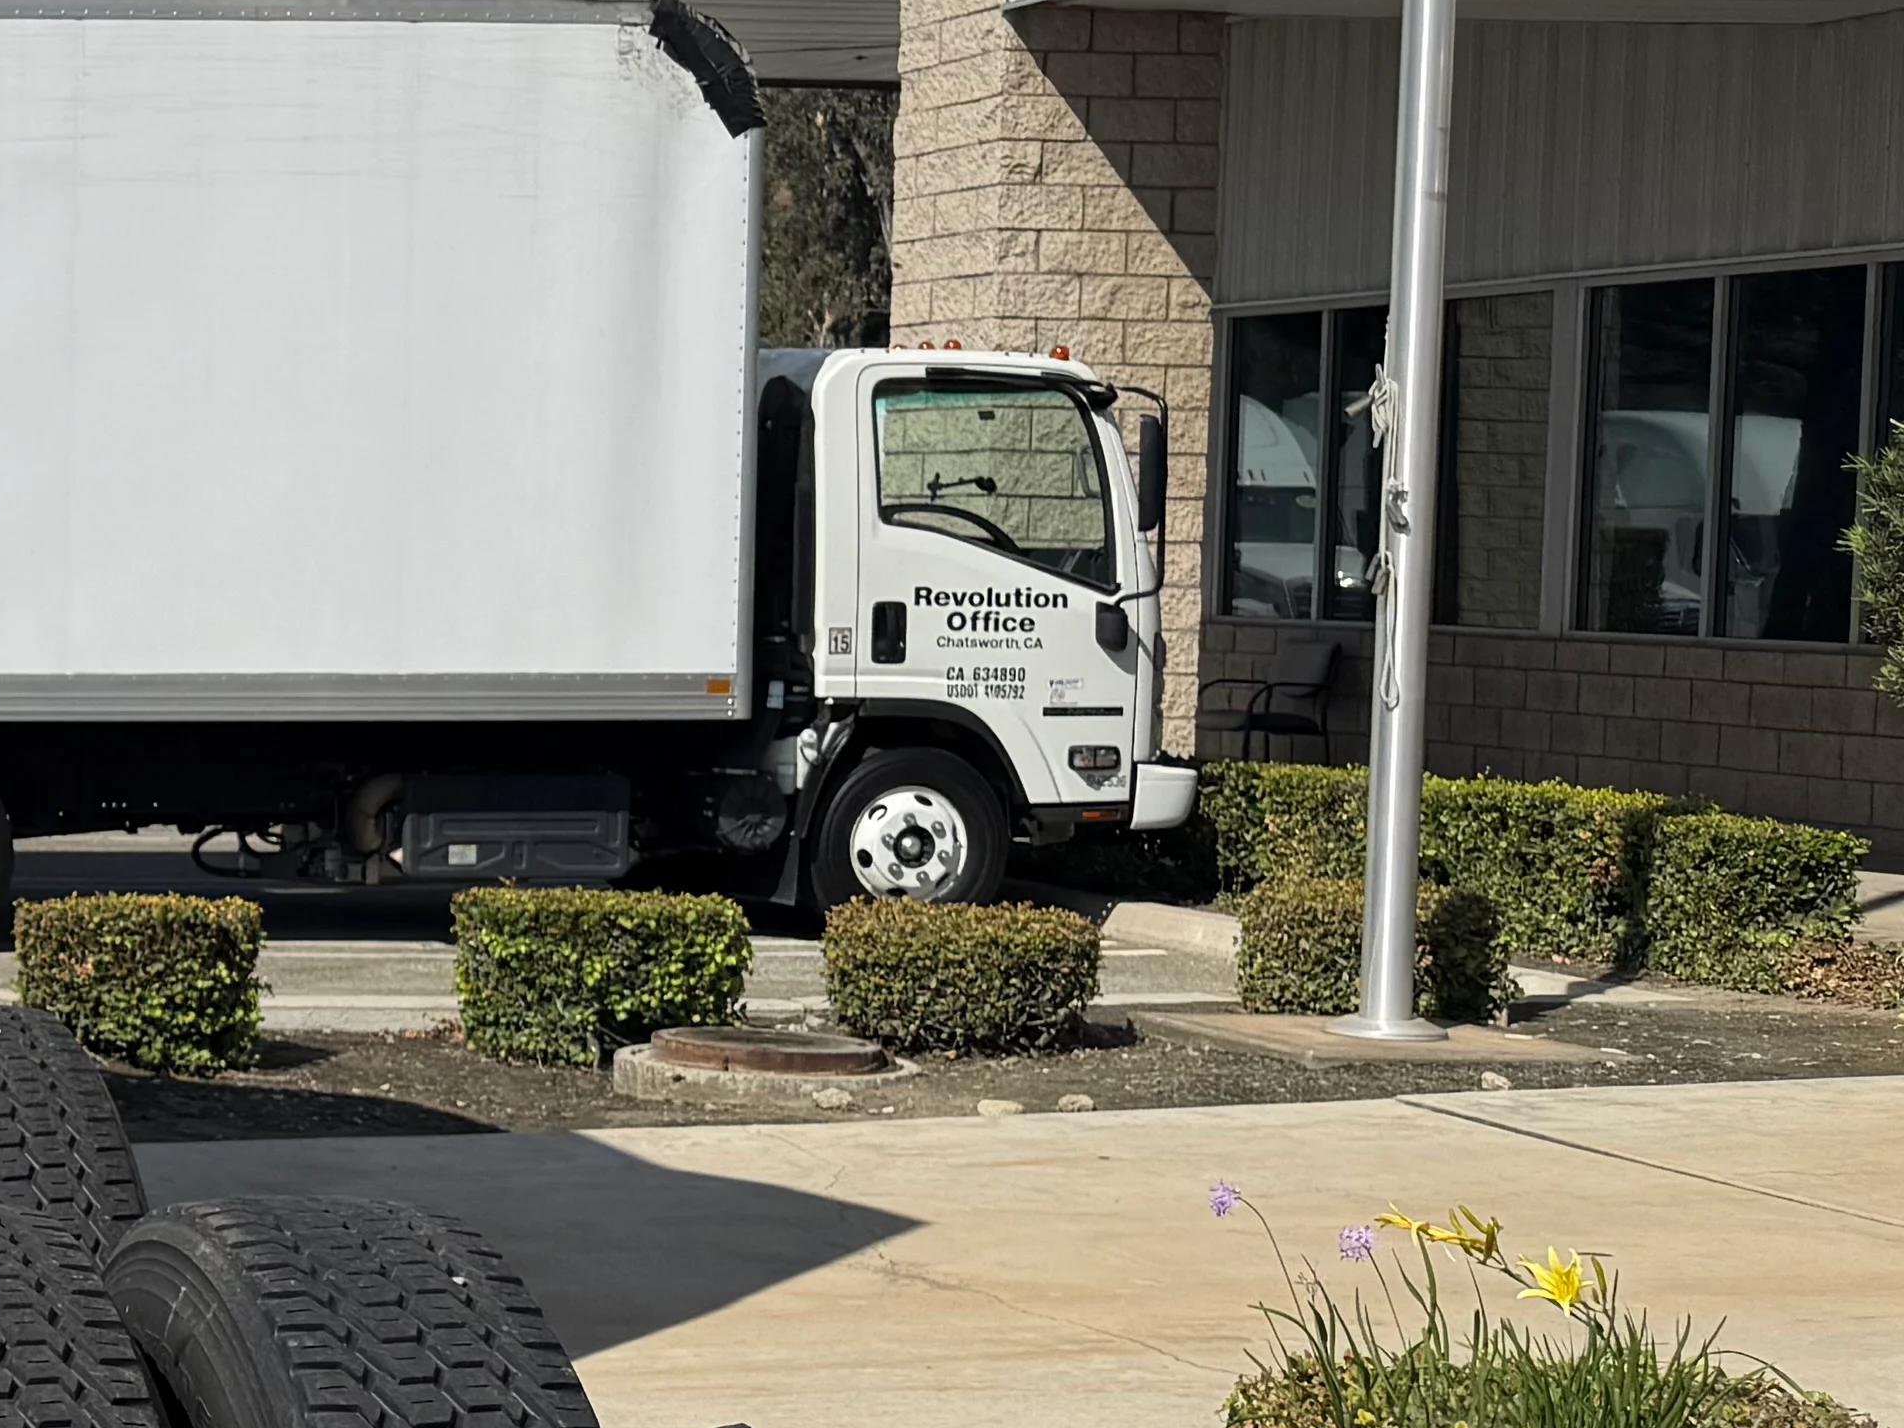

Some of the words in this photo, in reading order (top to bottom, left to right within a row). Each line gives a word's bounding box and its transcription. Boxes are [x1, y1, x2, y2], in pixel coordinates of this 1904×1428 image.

[914, 586, 1069, 609] Revolution
[946, 610, 1036, 633] Office
[833, 635, 850, 652] 15
[1024, 637, 1043, 650] CA
[946, 666, 965, 682] CA
[972, 666, 1026, 683] 634890
